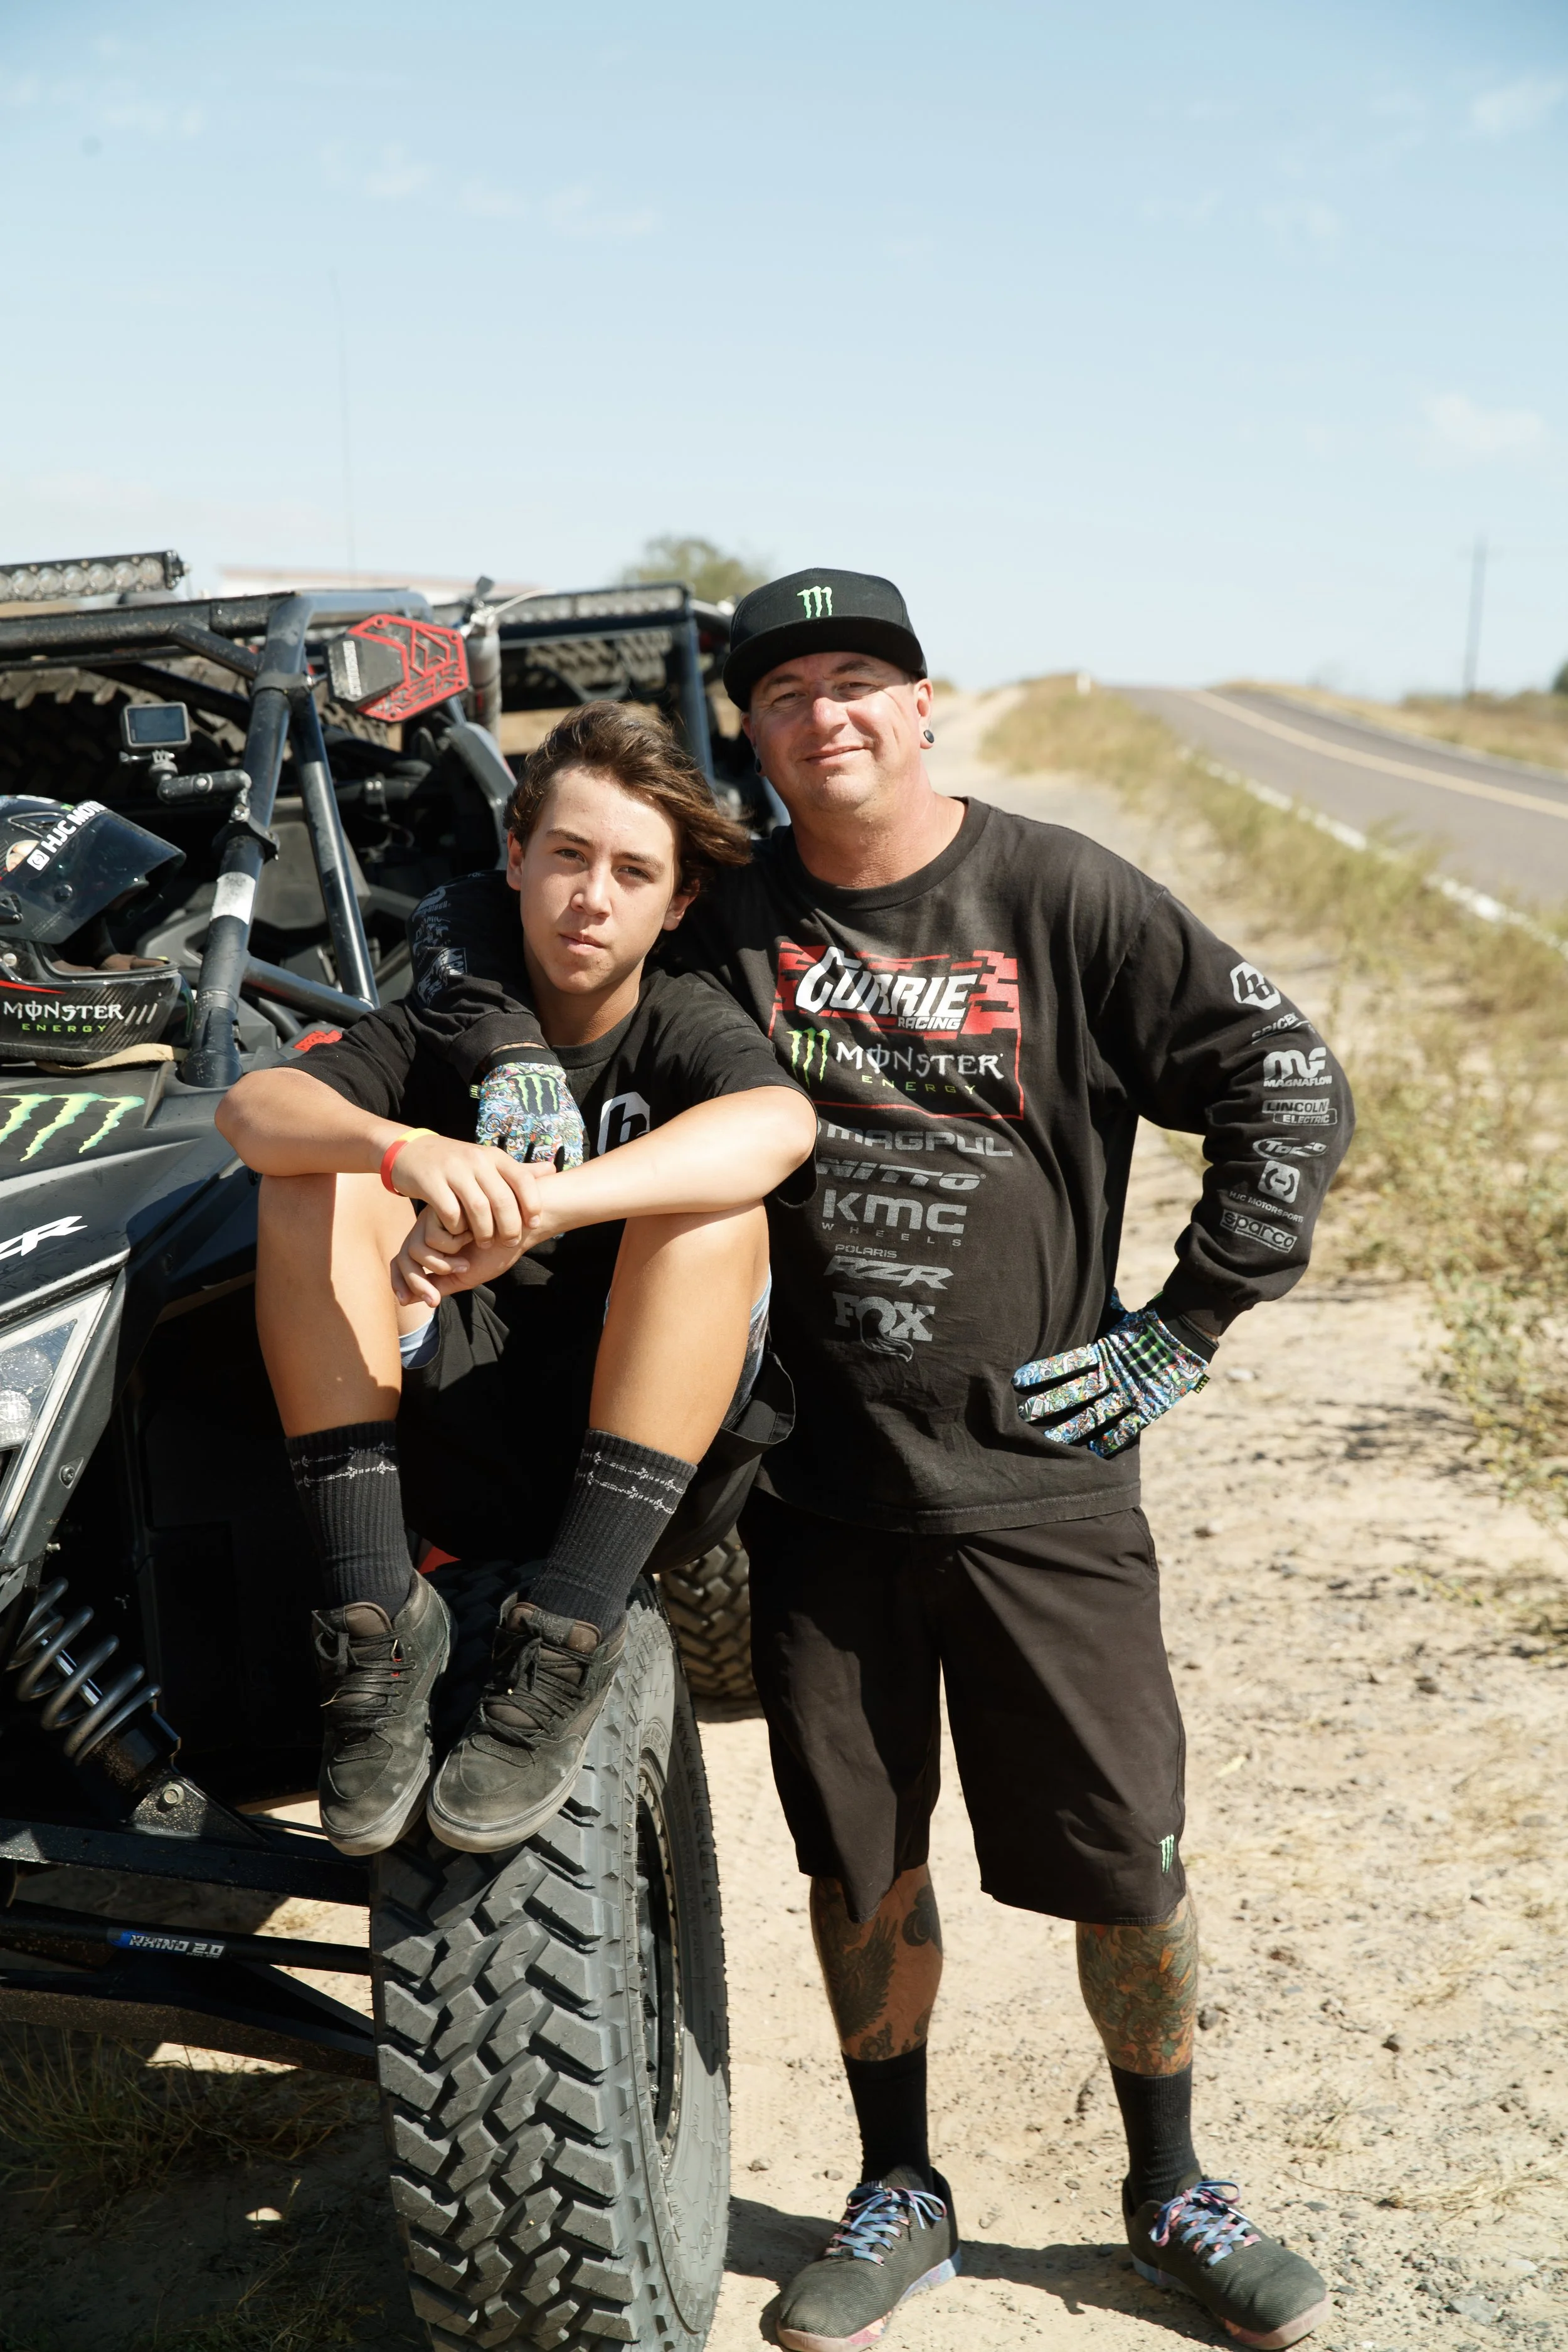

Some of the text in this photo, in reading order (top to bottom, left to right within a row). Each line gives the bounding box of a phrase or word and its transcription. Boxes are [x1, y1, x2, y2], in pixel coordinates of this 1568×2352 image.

[41, 820, 77, 853] HJC
[796, 946, 978, 1018] CURRIE
[3, 1000, 124, 1022] MONSTER
[22, 1024, 107, 1032] ENERGY
[898, 1017, 963, 1029] RACING
[836, 1042, 1005, 1079] MONSTER
[861, 1074, 976, 1094] ENERGY
[1263, 1076, 1332, 1087] MAGNAFLOW
[1266, 1102, 1327, 1113] LINCOLN
[1283, 1115, 1330, 1123] ELECTRIC
[827, 1123, 1013, 1157] MAGPUL
[816, 1158, 980, 1190] NITTO
[1229, 1191, 1247, 1201] HJC
[822, 1222, 961, 1246] WHEELS
[1224, 1212, 1294, 1248] sparco
[835, 1244, 897, 1258] POLARIS
[824, 1255, 954, 1289] RZR
[832, 1291, 935, 1343] FOX
[1196, 1377, 1209, 1392] FIST
[129, 1935, 225, 1956] RHINO 2.0
